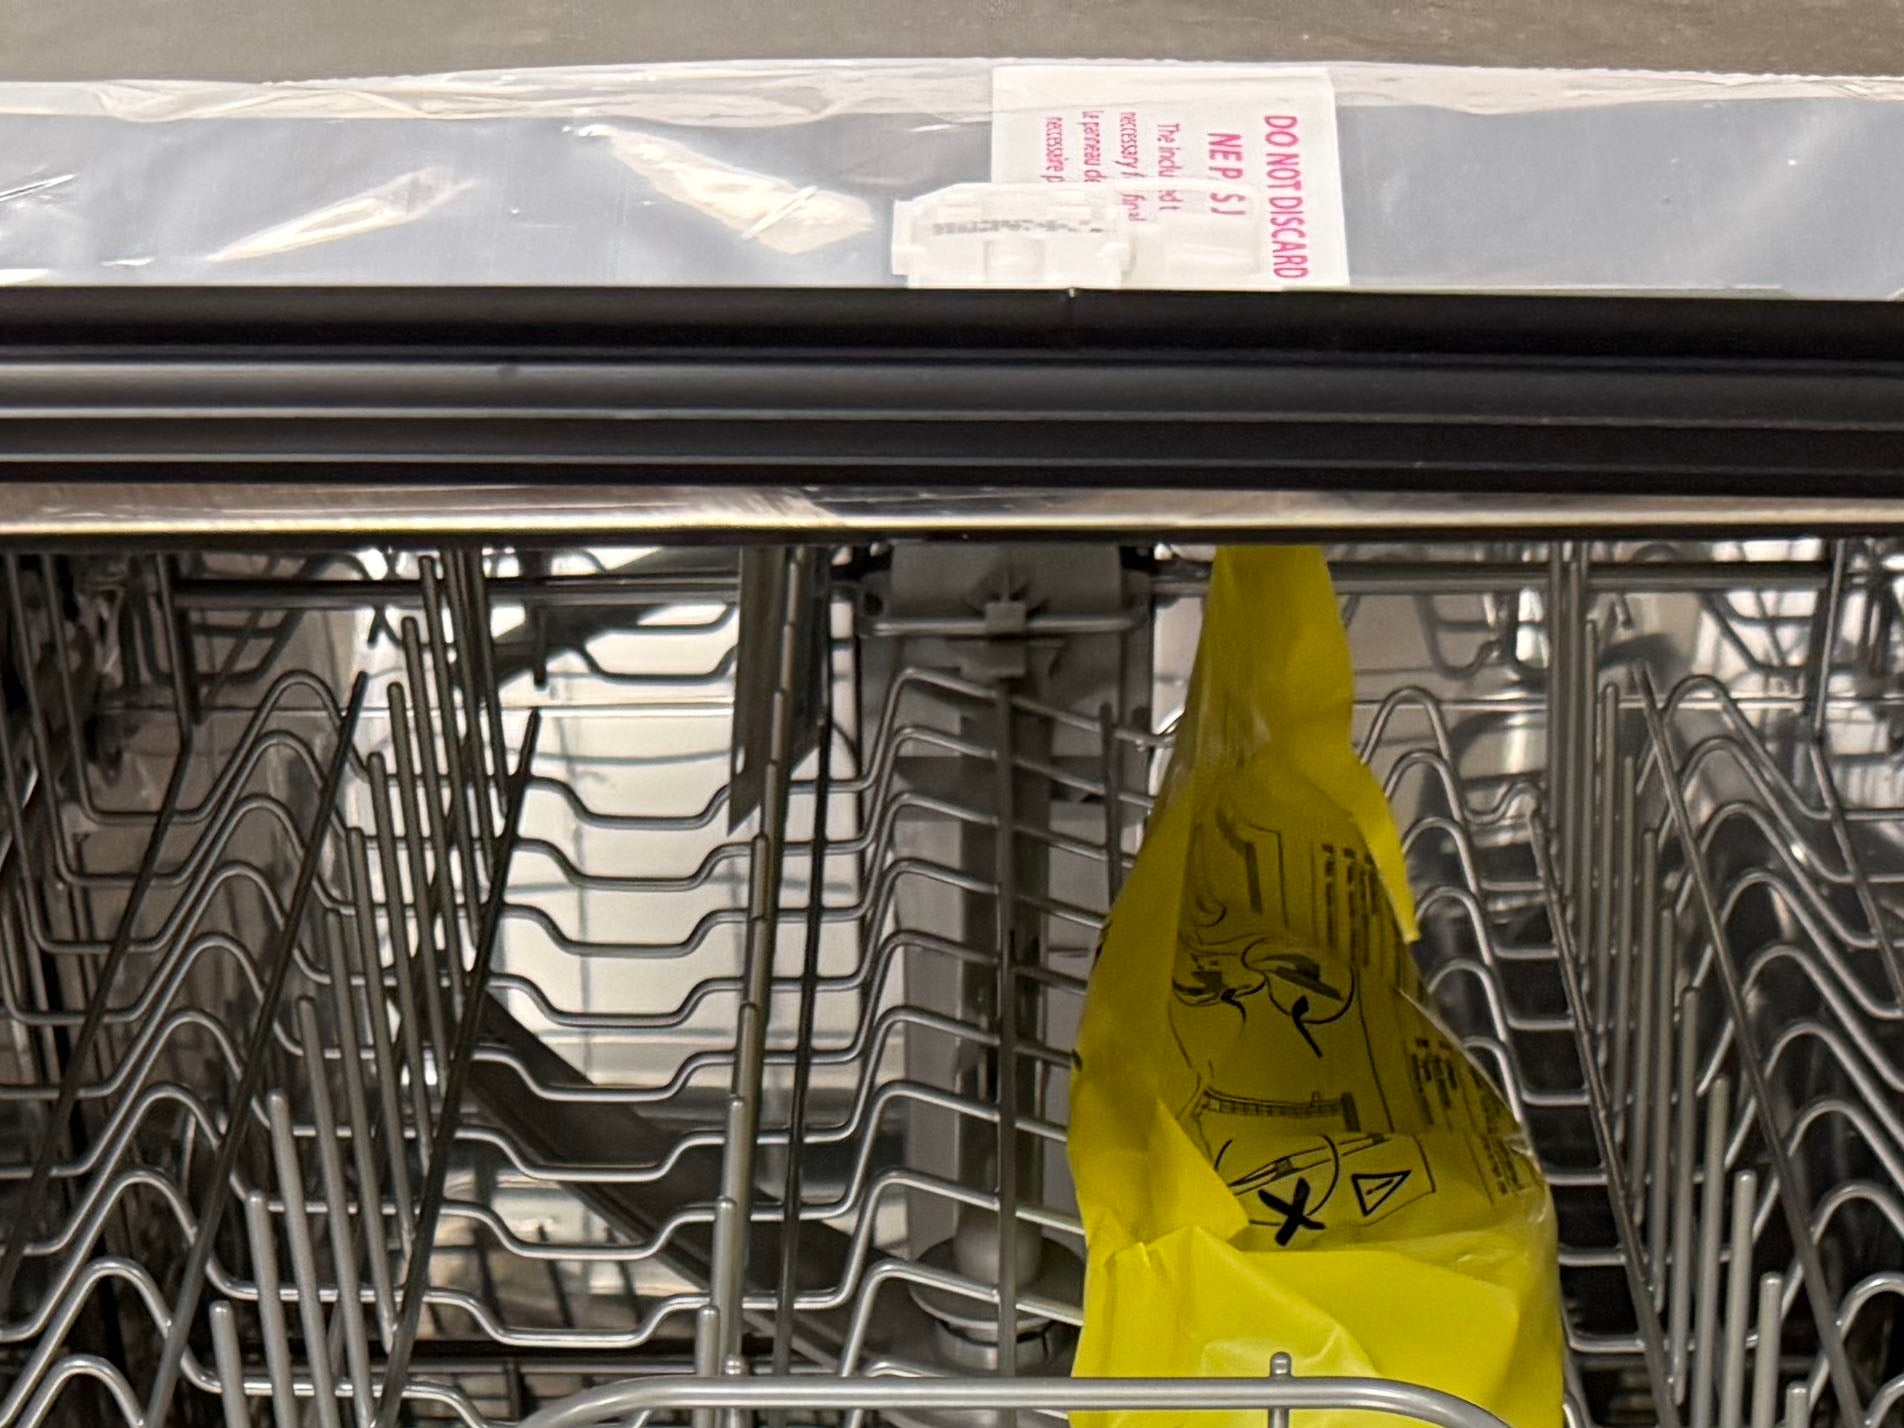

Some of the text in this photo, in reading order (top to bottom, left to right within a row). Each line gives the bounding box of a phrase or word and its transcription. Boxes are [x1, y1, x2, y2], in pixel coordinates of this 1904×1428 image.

[1157, 123, 1181, 143] The
[1207, 133, 1243, 161] NE
[1158, 146, 1184, 202] inclued
[1208, 166, 1247, 203] PS
[1264, 115, 1309, 278] DO NOT DISCARD
